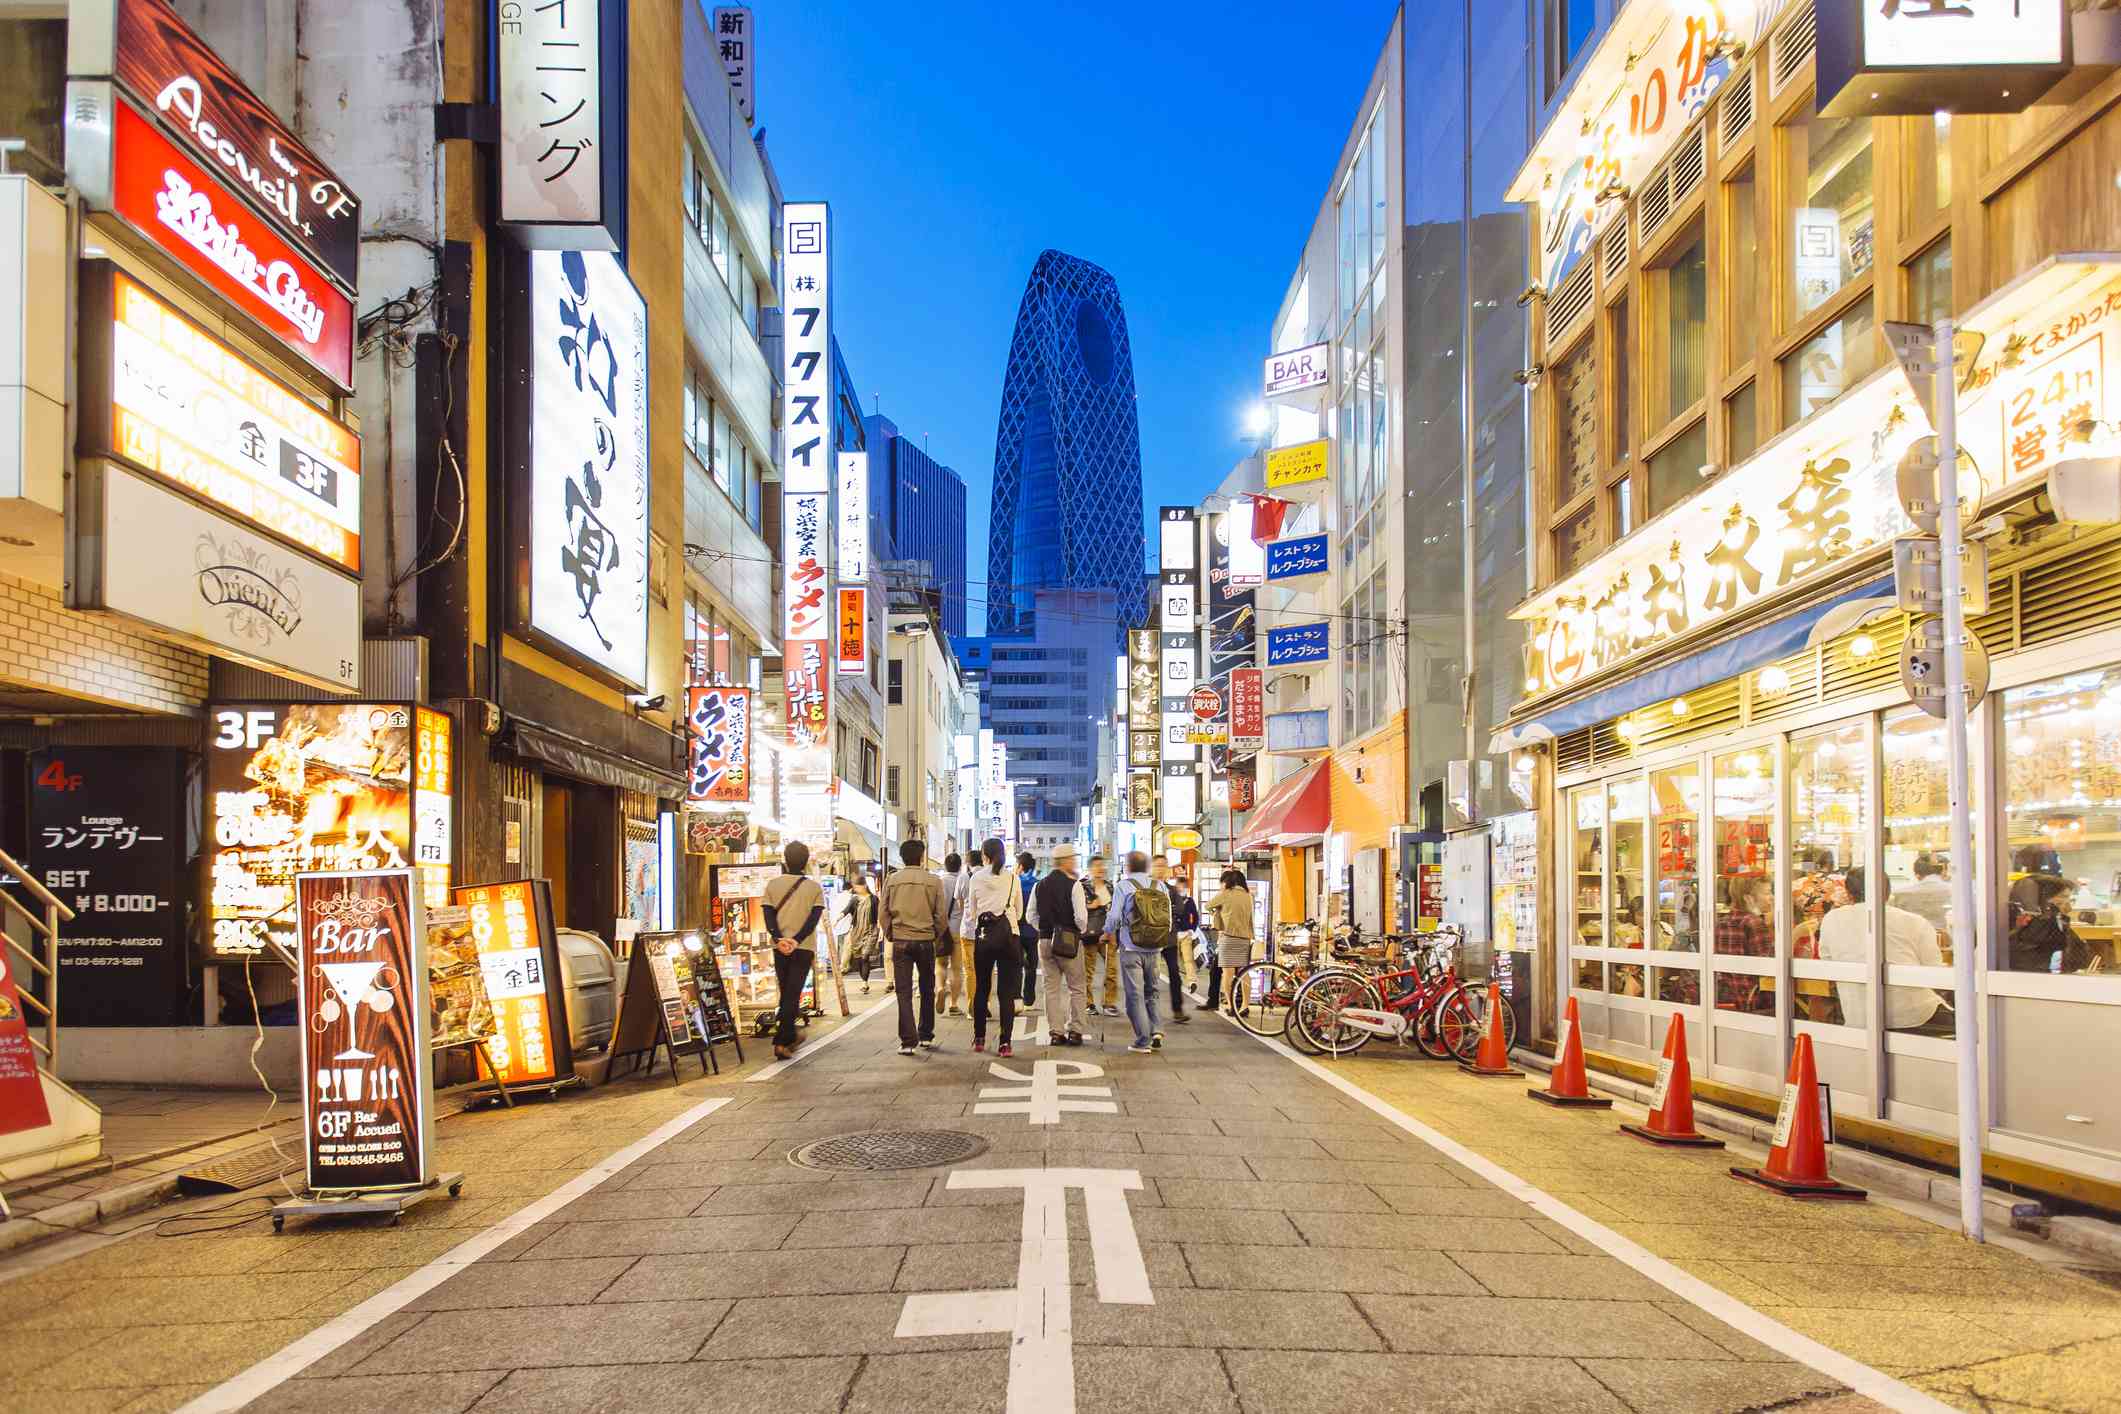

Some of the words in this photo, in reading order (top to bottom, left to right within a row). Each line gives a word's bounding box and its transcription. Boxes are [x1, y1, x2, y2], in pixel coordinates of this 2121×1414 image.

[310, 180, 356, 220] 6F
[1273, 354, 1313, 380] BAR
[294, 452, 328, 497] 3F
[1274, 543, 1321, 558] レストラン
[199, 565, 302, 636] Oriental
[1275, 630, 1322, 644] レストラン
[339, 660, 354, 678] 5F
[1193, 698, 1219, 710] 消火栓
[214, 711, 275, 749] 3F
[695, 693, 726, 795] ラーメン
[37, 761, 82, 791] 4F
[81, 816, 124, 825] Lounge
[41, 826, 163, 849] ランデヴー
[46, 871, 90, 888] SET
[313, 918, 392, 954] Bar
[318, 1111, 351, 1138] 6F
[354, 1111, 378, 1124] Bar
[354, 1122, 401, 1137] Accueil
[319, 1156, 336, 1166] TEL
